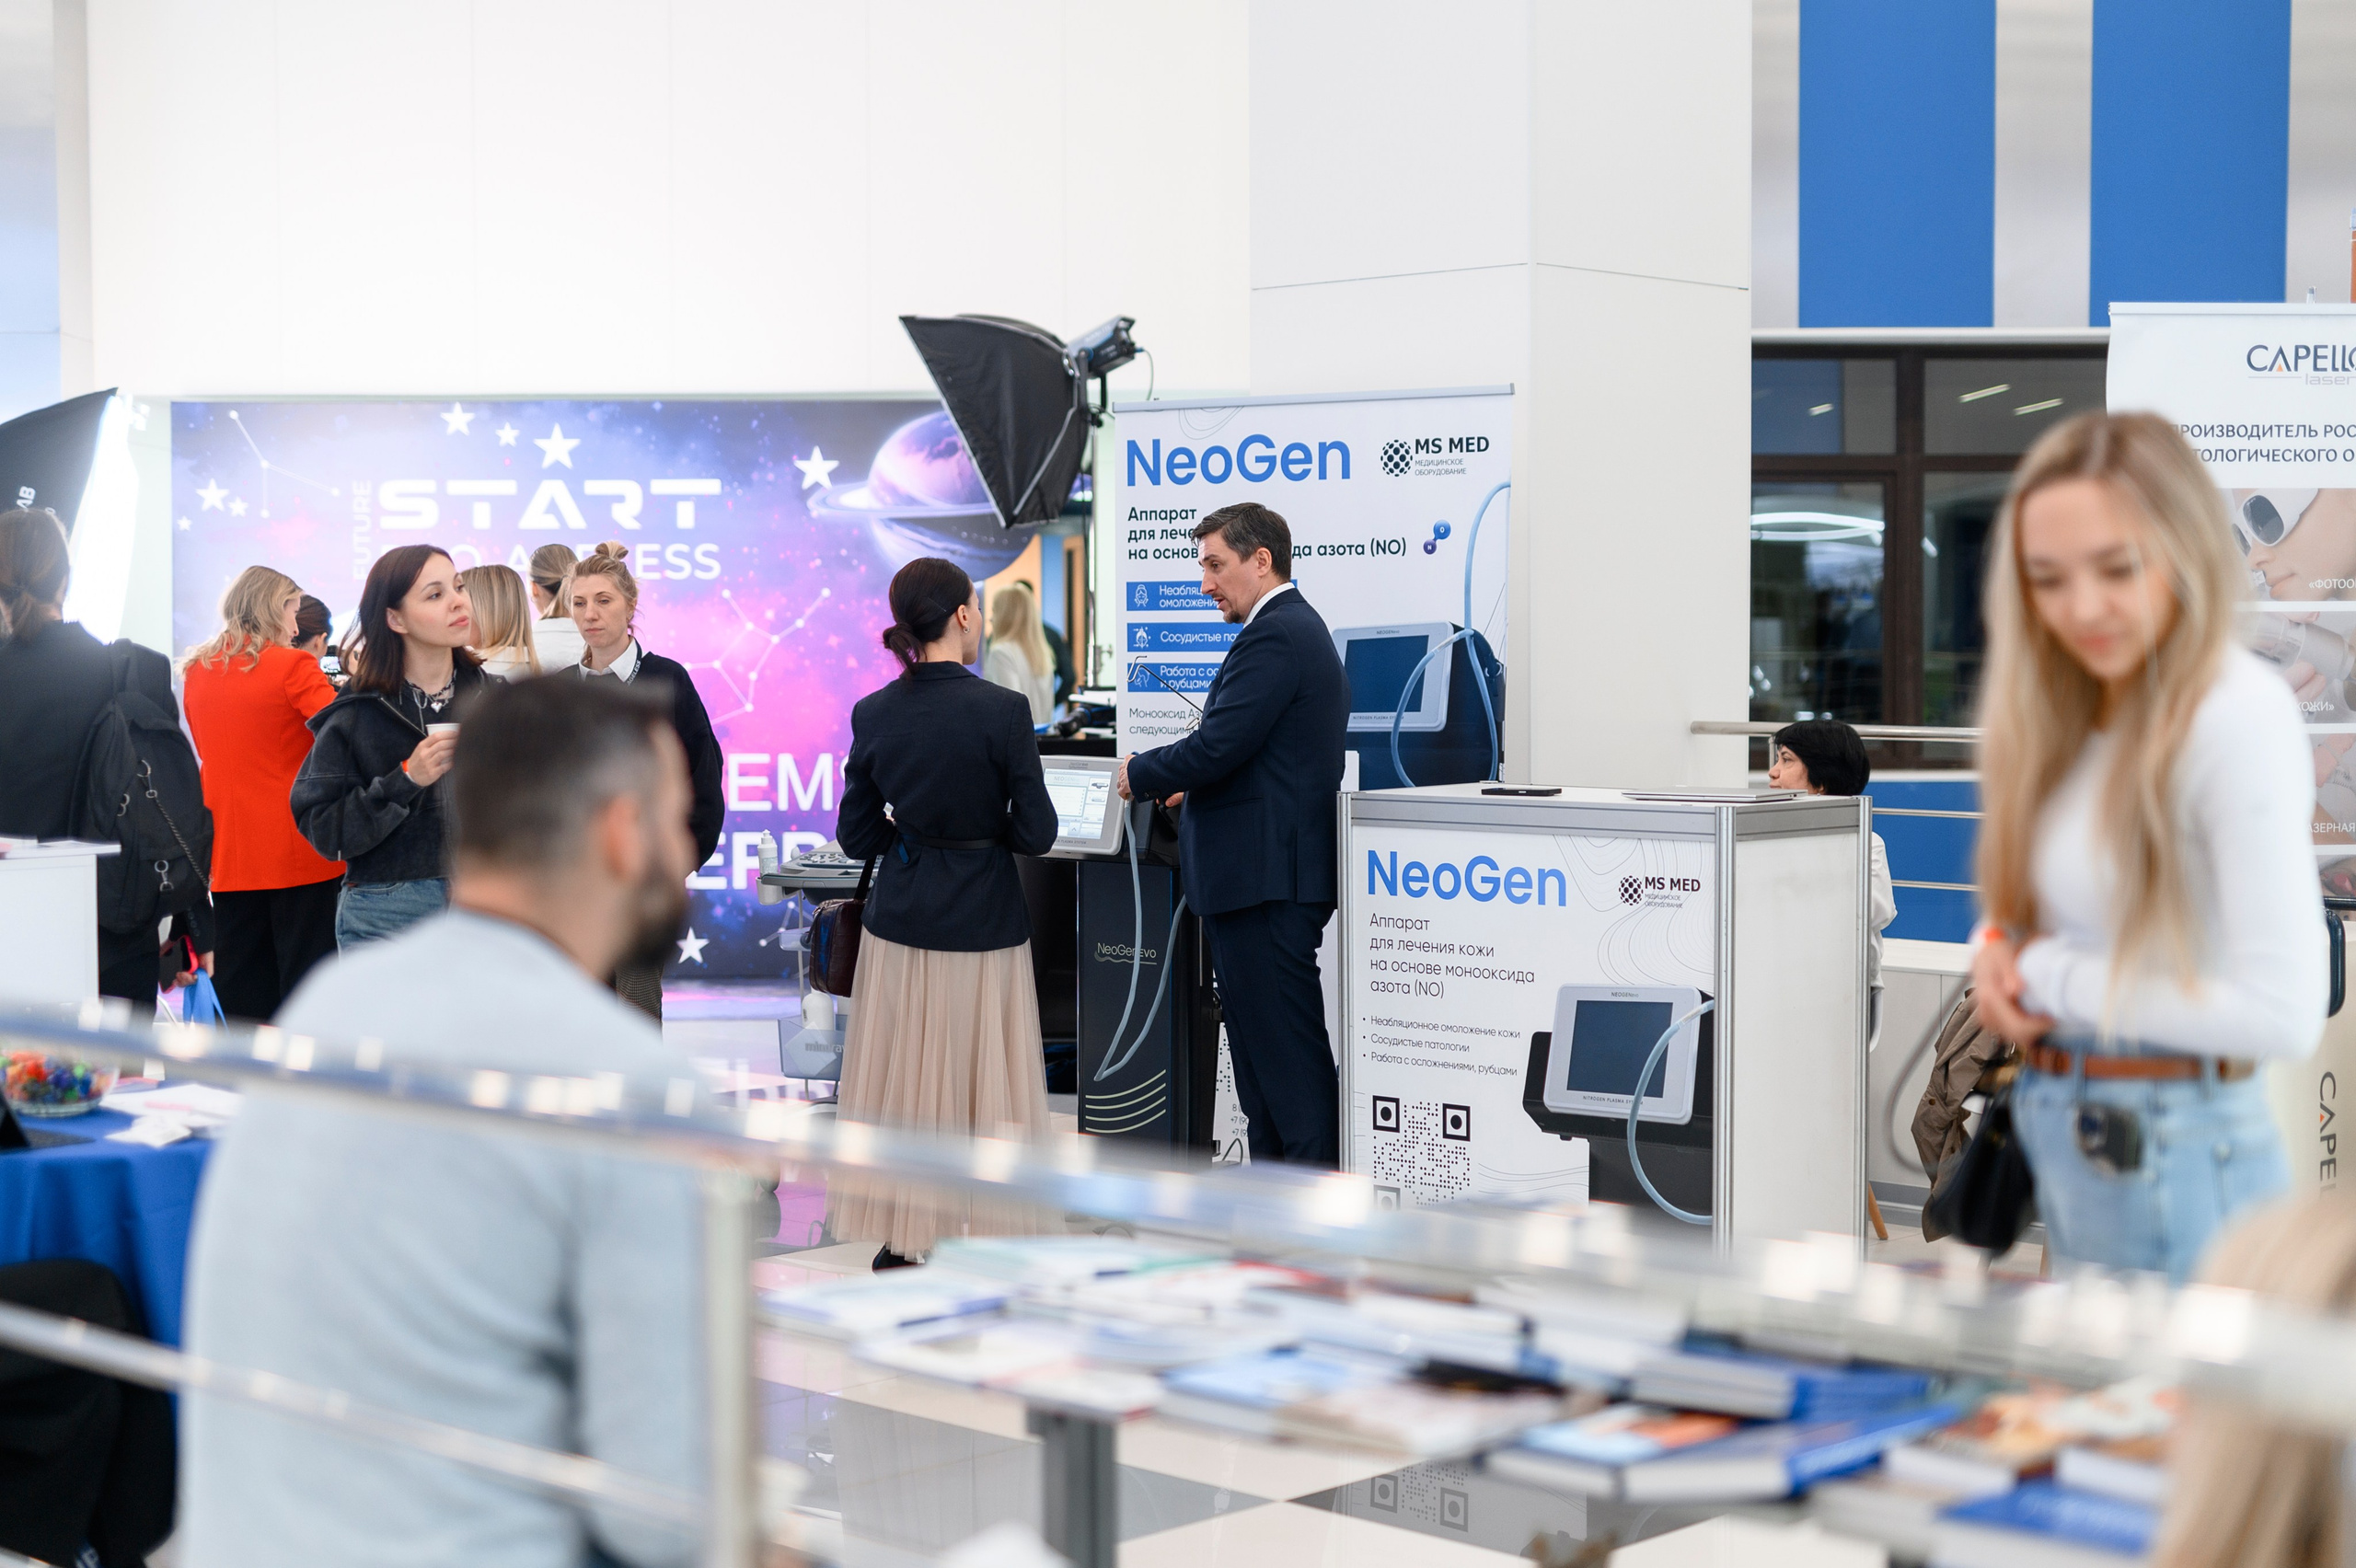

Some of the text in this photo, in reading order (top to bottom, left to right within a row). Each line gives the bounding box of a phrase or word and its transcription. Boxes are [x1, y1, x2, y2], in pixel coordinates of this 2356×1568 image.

[1415, 436, 1490, 455] MS MED
[1126, 434, 1352, 486] NeoGen
[1415, 458, 1464, 467] МЕДИЦИНСКОЕ
[1415, 467, 1467, 477] ОБОРУДОВАНИЕ
[378, 478, 722, 530] START
[1127, 506, 1197, 525] Аппарат
[353, 479, 372, 581] FUTURE
[1127, 529, 1155, 543] для
[1128, 548, 1148, 559] на
[1317, 544, 1365, 557] азота
[1370, 537, 1406, 558] (NO)
[2309, 578, 2356, 589] «ФОТОО
[1160, 631, 1222, 644] Сосудистые
[1160, 665, 1195, 676] Работа
[1129, 708, 1185, 720] Монооксид
[1368, 849, 1567, 907] NeoGen
[1645, 876, 1701, 892] MS MED
[1369, 913, 1430, 932] Аппарат
[1369, 938, 1495, 958] для лечения кожи
[1370, 959, 1535, 983] на основе монооксида
[1370, 979, 1445, 999] азота (NO)
[1370, 1015, 1520, 1039] Неабляционное омоложение кожи
[1370, 1033, 1470, 1053] Сосудистые патологии
[1370, 1052, 1403, 1065] Работа
[1411, 1058, 1477, 1073] осложнениями,
[1478, 1064, 1518, 1076] рубцами
